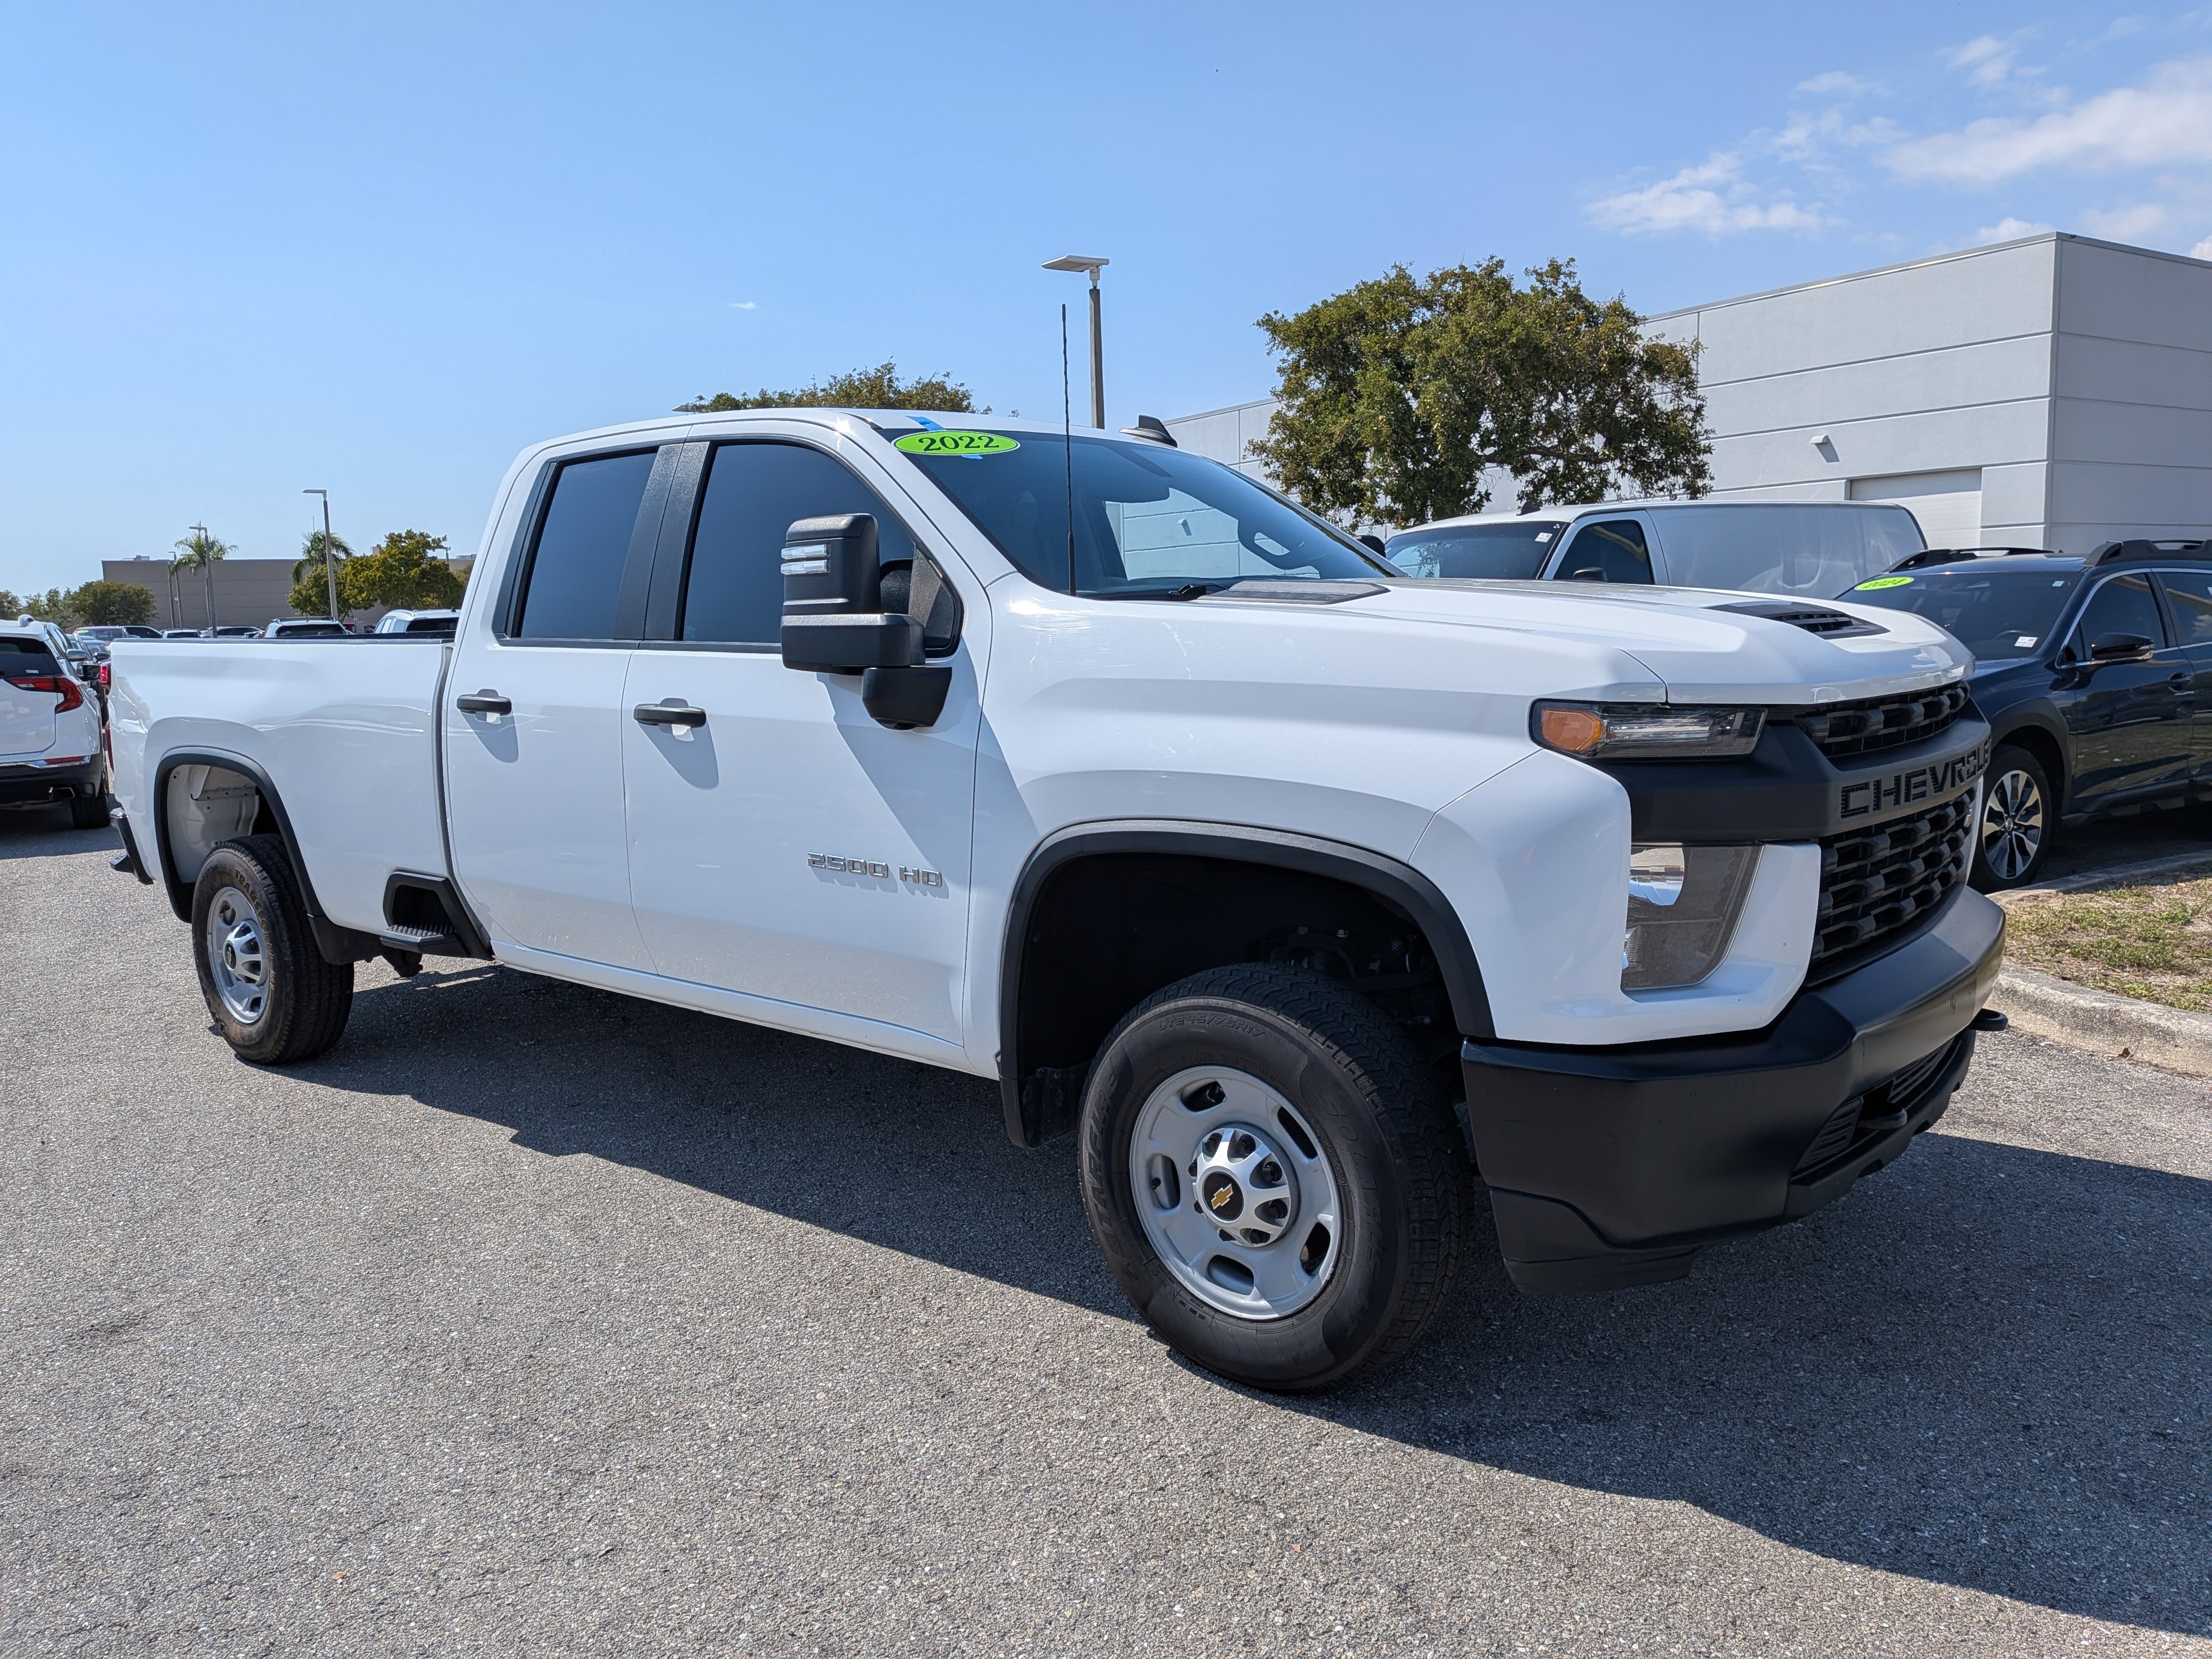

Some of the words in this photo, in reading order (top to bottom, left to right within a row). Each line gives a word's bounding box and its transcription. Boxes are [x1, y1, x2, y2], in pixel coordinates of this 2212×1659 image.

[919, 436, 999, 451] 2022
[1840, 736, 1992, 818] CHEVROLE
[807, 851, 889, 878] 2500
[899, 865, 942, 887] HD
[1088, 1068, 1125, 1258] STARFIRE
